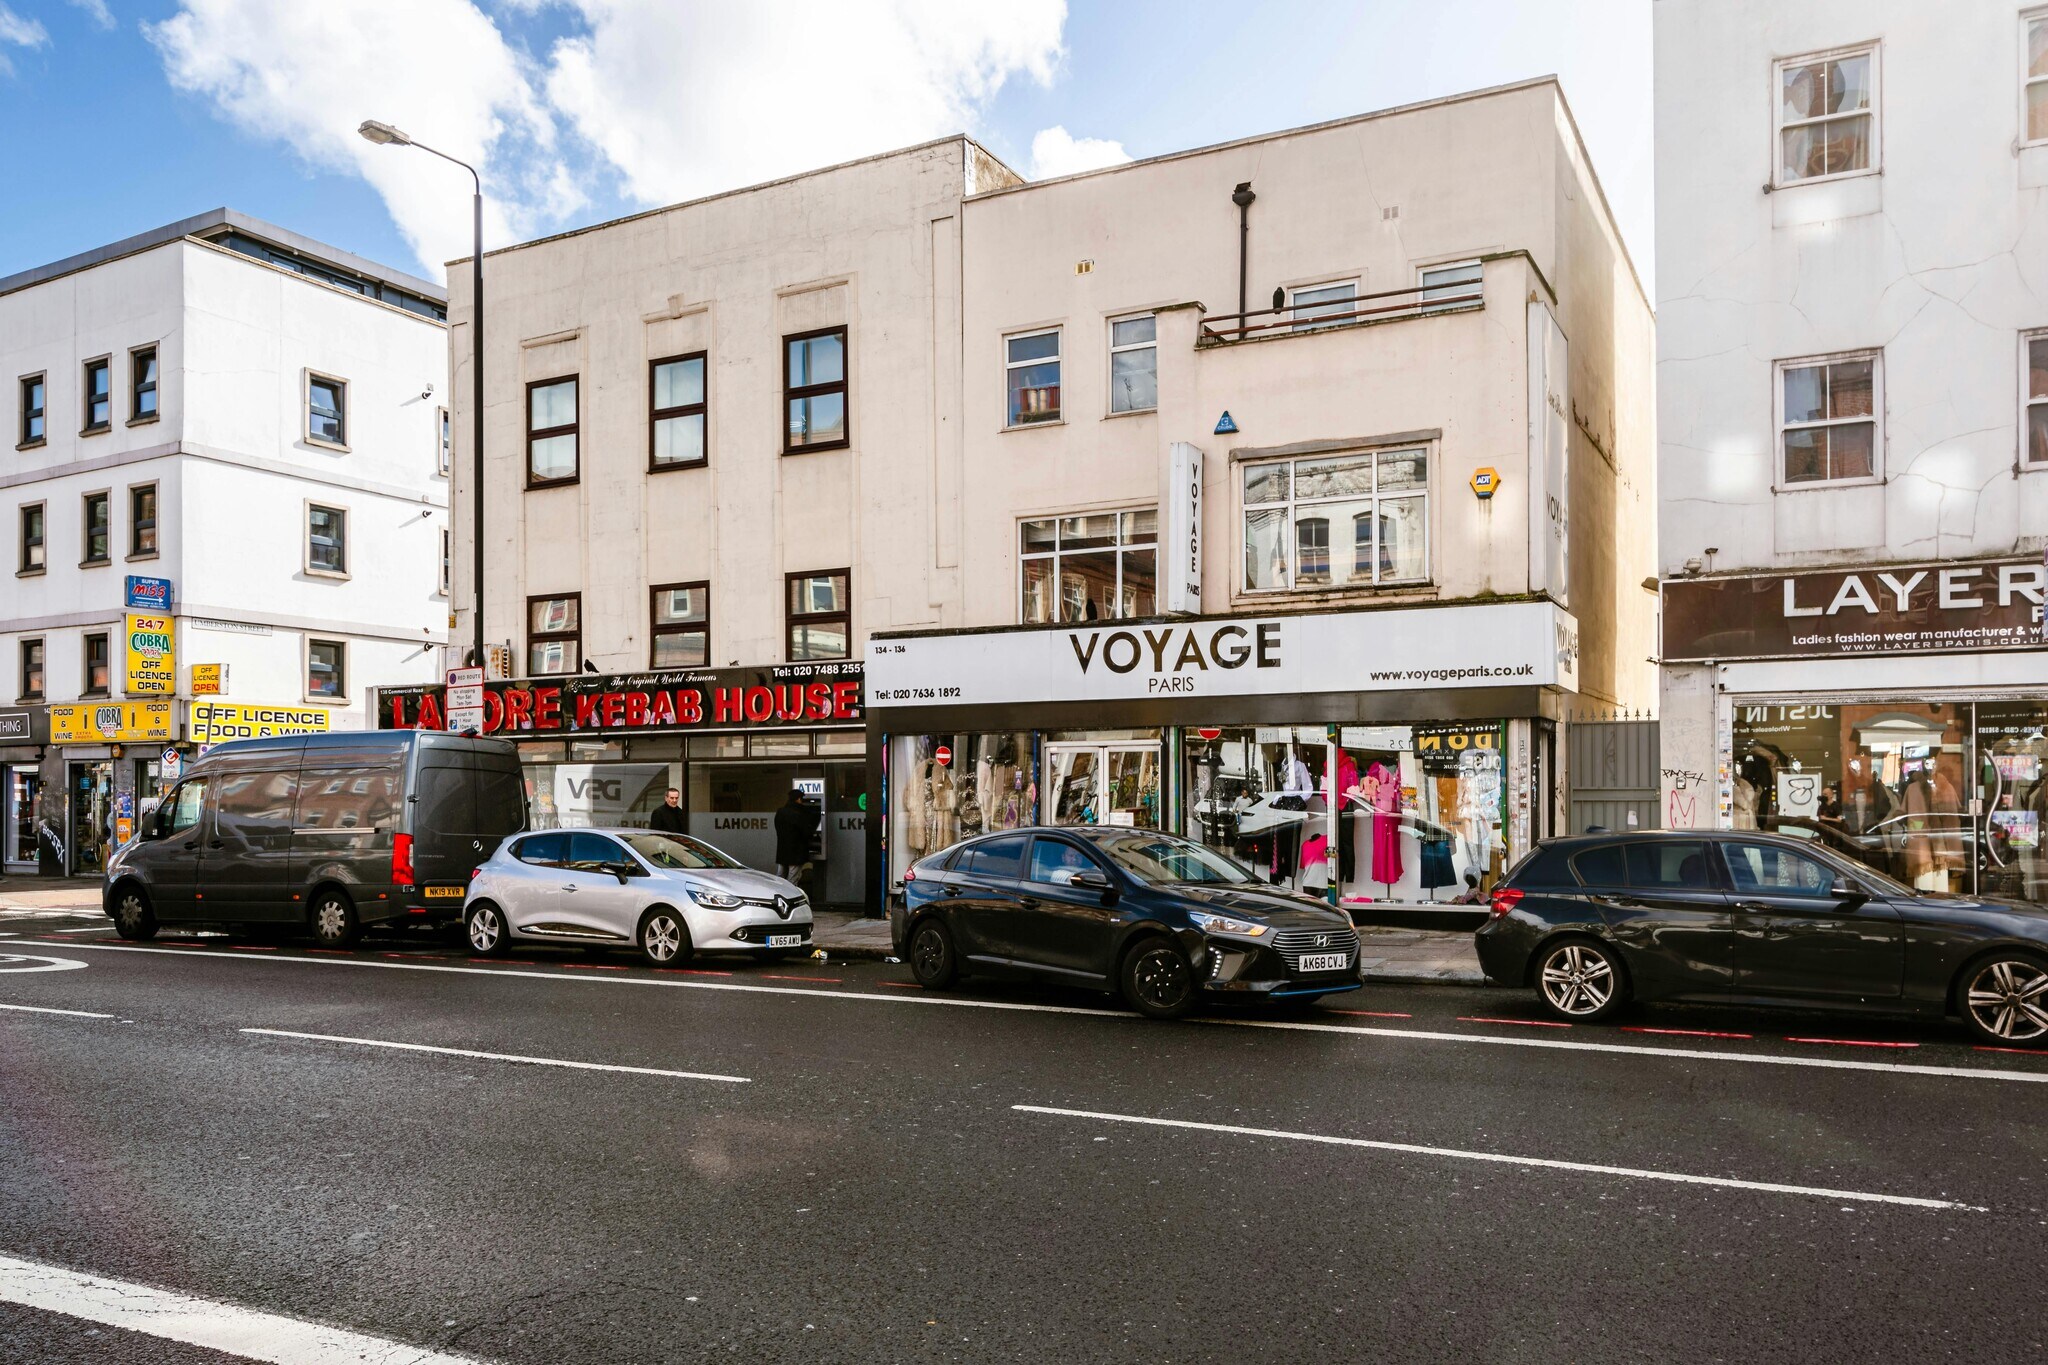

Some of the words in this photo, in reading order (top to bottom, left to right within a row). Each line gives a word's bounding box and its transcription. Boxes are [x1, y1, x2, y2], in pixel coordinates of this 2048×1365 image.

[1477, 476, 1490, 484] ADT
[1190, 463, 1198, 573] VOYAGE
[1187, 582, 1200, 597] PARIS
[136, 618, 164, 630] 24/7
[240, 624, 266, 632] STREET
[130, 632, 170, 652] COBRA
[1792, 634, 1832, 645] Ladies
[1834, 632, 1880, 644] fashion
[1884, 632, 1918, 641] wear
[1920, 627, 2013, 640] manufacturer
[2016, 626, 2026, 636] &
[1069, 622, 1281, 675] VOYAGE
[142, 660, 160, 668] OFF
[130, 670, 172, 680] LICENCE
[772, 667, 791, 677] Tel:
[794, 666, 812, 676] 020
[814, 665, 839, 674] 7488
[1370, 664, 1534, 681] www.voyageparis.co.uk
[138, 682, 165, 690] OPEN
[610, 676, 625, 686] The
[627, 674, 657, 688] Original
[686, 672, 716, 682] Famous
[1149, 676, 1194, 693] PARIS
[875, 690, 891, 700] Tel:
[894, 690, 910, 699] 020
[912, 688, 934, 698] 7636
[938, 687, 960, 697] 1892
[393, 688, 561, 733] LAORE
[576, 689, 703, 728] KEBAB
[715, 682, 860, 723] HOUSE
[96, 706, 123, 730] COBRA
[196, 707, 236, 720] OFF
[244, 710, 324, 724] LICENCE
[54, 732, 73, 740] WINE
[147, 729, 167, 737] WINE
[194, 724, 252, 738] FOOD
[798, 783, 822, 793] ATM
[714, 818, 768, 830] LAHORE
[770, 936, 788, 946] LV65
[788, 936, 800, 945] AWU
[1303, 957, 1326, 970] AK68
[1328, 956, 1344, 968] CVJ
